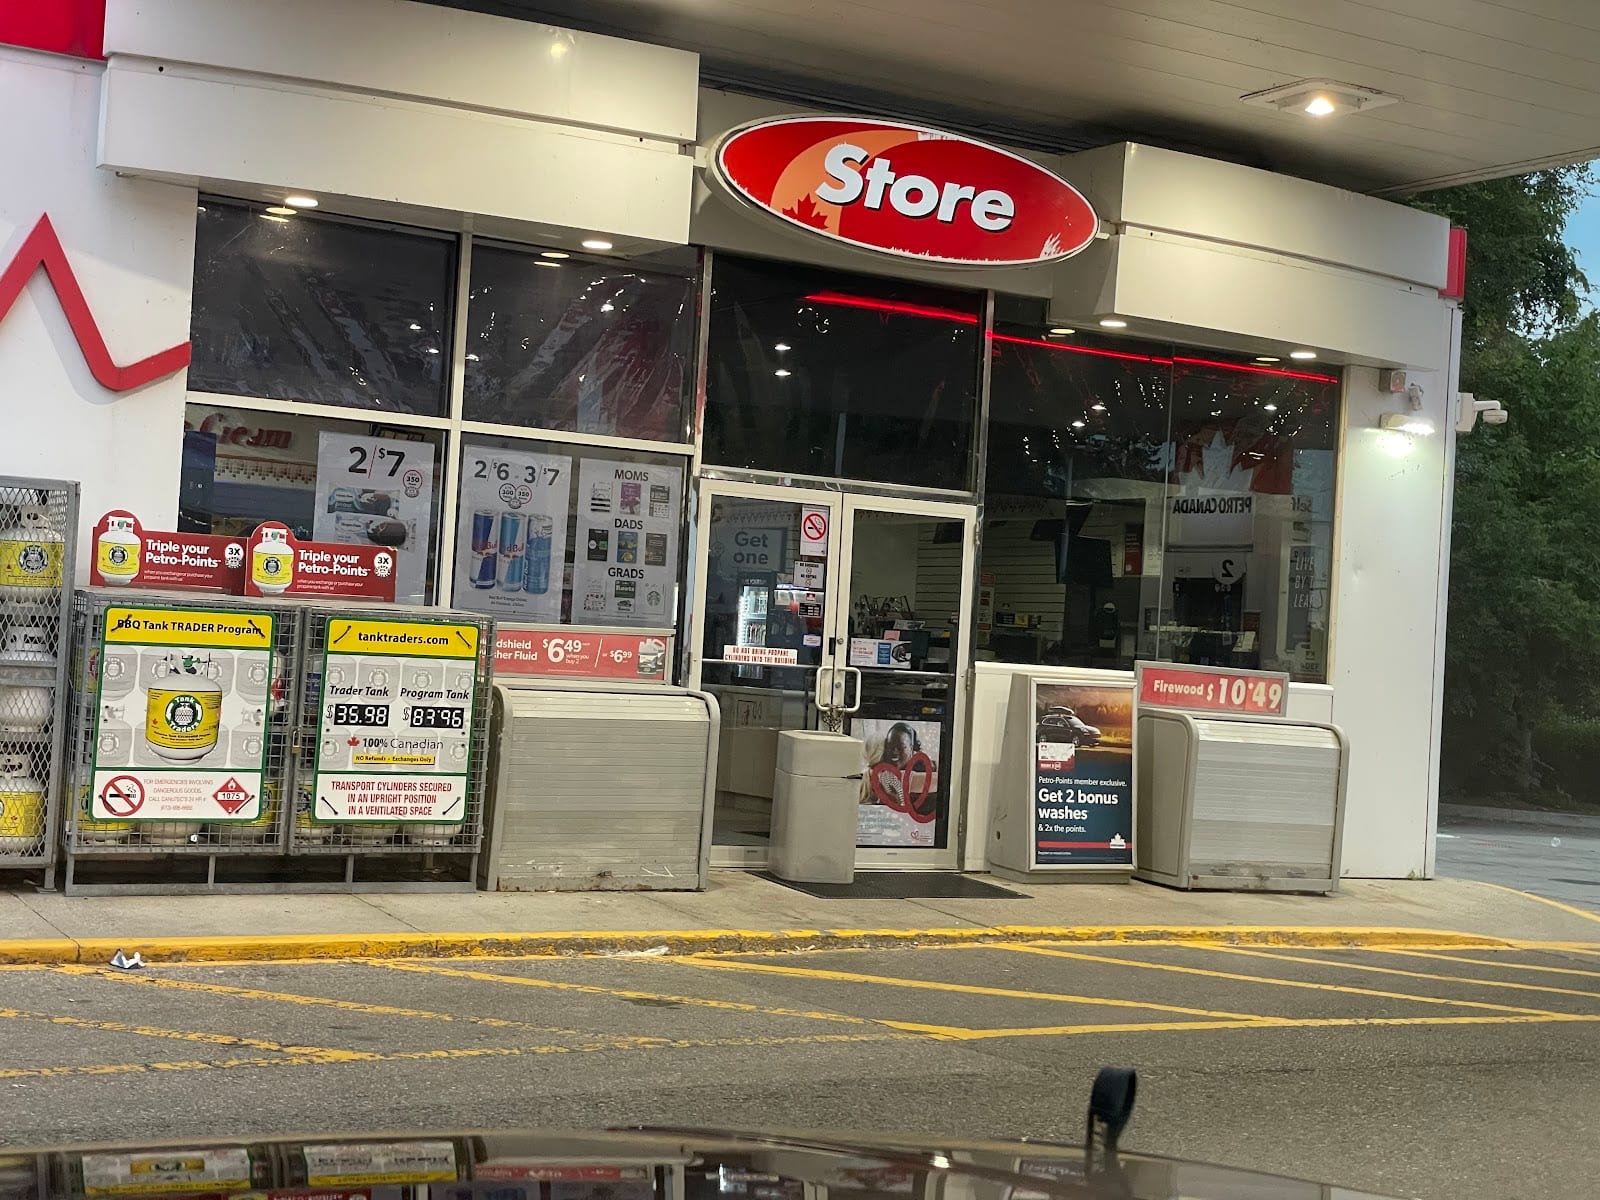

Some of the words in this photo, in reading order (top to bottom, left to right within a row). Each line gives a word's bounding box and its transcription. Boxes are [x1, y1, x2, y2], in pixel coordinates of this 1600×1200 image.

[815, 142, 1015, 232] Store
[614, 469, 649, 482] MOMS
[614, 519, 643, 529] DADS
[734, 531, 768, 548] Get
[145, 539, 179, 552] Triple
[182, 544, 209, 555] your
[228, 547, 241, 556] 3X
[298, 549, 331, 562] Triple
[333, 553, 359, 564] your
[377, 556, 389, 565] 3X
[733, 552, 768, 564] one
[608, 567, 644, 579] GRADS
[117, 620, 140, 629] BBQ
[142, 620, 168, 630] Tank
[171, 622, 214, 632] TRADER
[217, 624, 261, 635] Program
[358, 632, 449, 645] tanktraders.com
[496, 639, 532, 649] dshield
[494, 650, 513, 659] her
[514, 651, 538, 660] Fluid
[330, 685, 363, 696] Trader
[365, 686, 389, 697] Tank
[400, 688, 443, 700] Program
[446, 689, 469, 700] Tank
[1154, 680, 1204, 696] Firewood
[170, 721, 199, 732] Traders
[363, 738, 388, 748] 100%
[390, 738, 444, 749] Canadian
[332, 781, 375, 791] TRANSPORT
[378, 782, 417, 791] CYLINDERS
[420, 782, 452, 792] SECURED
[1039, 776, 1073, 785] Petro-Points
[348, 794, 355, 802] IN
[358, 794, 368, 802] AN
[370, 794, 402, 803] UPRIGHT
[404, 794, 437, 803] POSITION
[1039, 788, 1063, 802] Get
[1066, 789, 1074, 803] 2
[1078, 790, 1119, 804] bonus
[349, 806, 356, 815] IN
[358, 806, 363, 815] A
[366, 806, 407, 815] VENTILATED
[410, 806, 432, 815] SPACE
[1038, 806, 1088, 820] washes
[1065, 825, 1086, 833] points.
